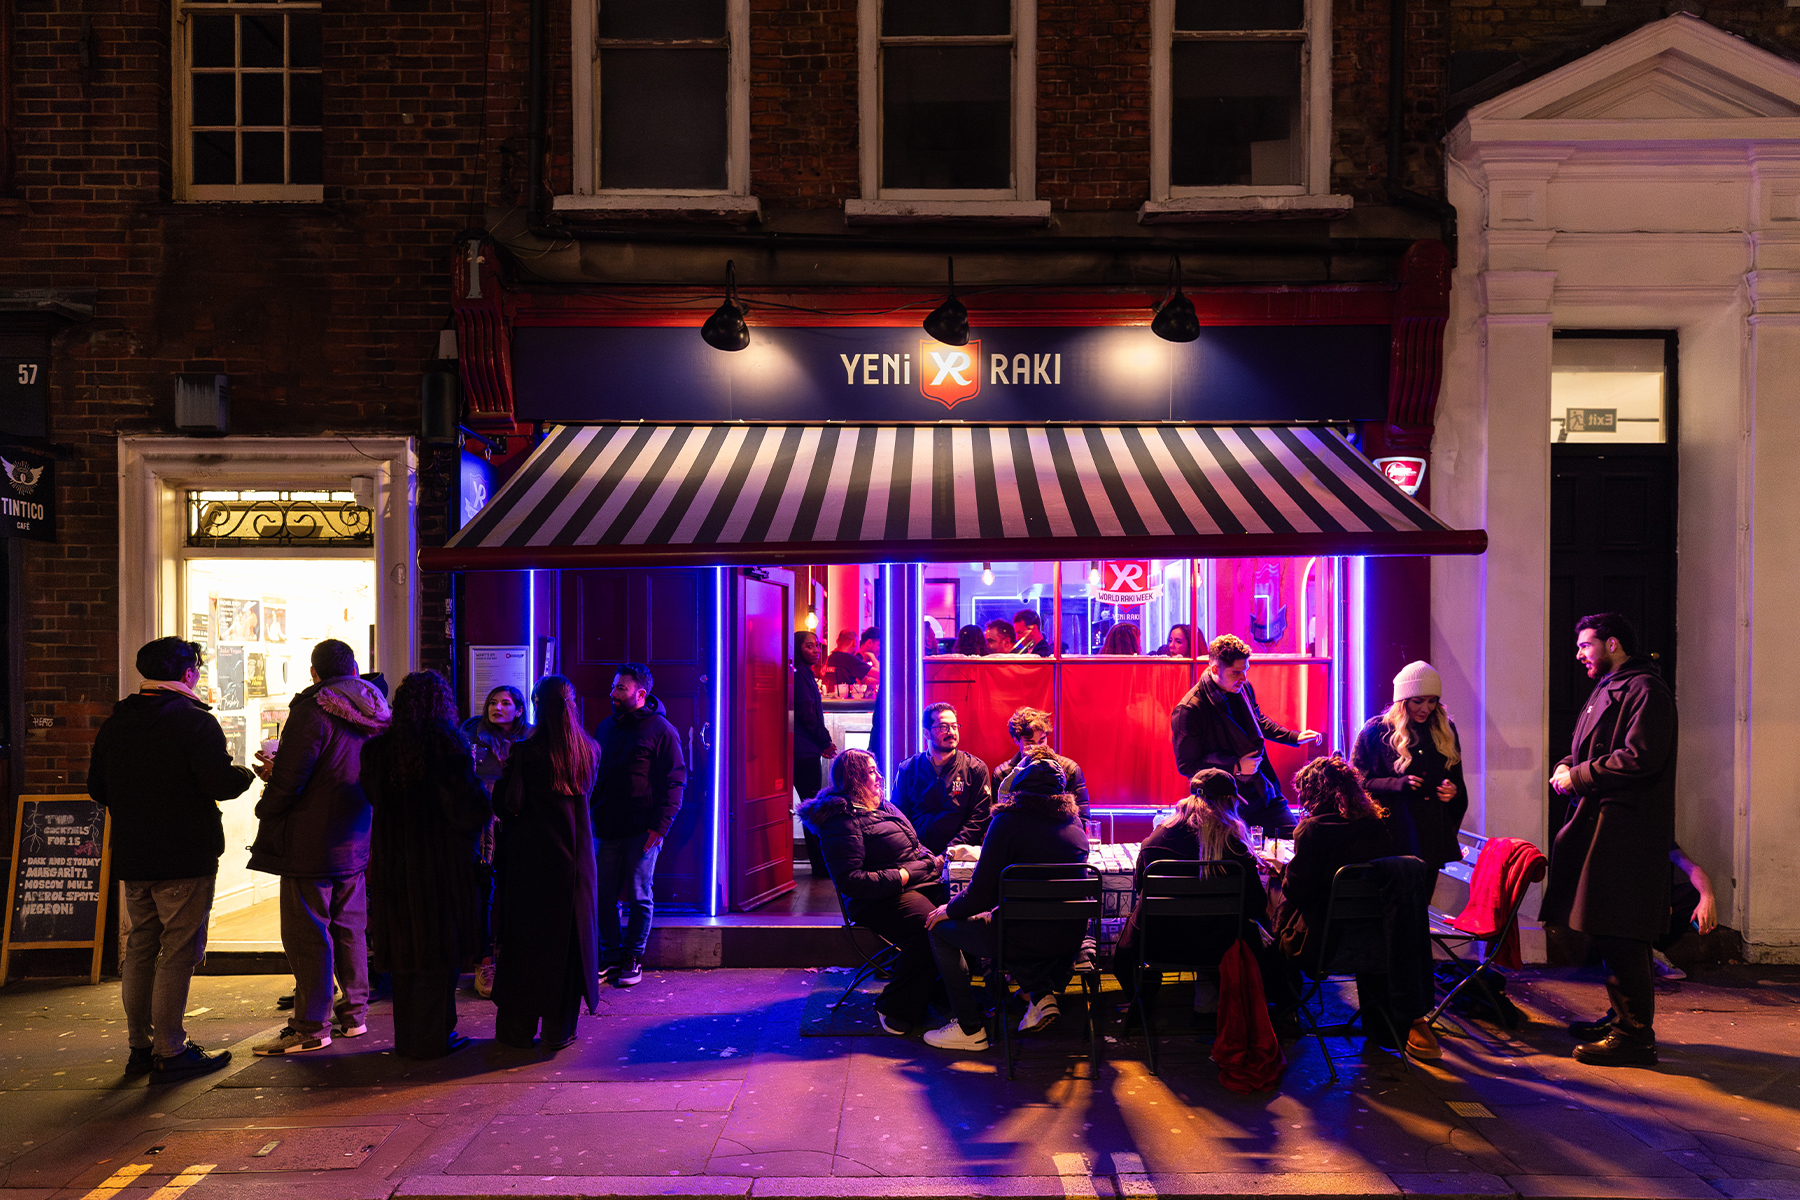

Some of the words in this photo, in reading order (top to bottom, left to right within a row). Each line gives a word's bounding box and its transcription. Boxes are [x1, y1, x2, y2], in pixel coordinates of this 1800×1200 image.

[990, 353, 1061, 385] RAKI
[18, 364, 38, 385] 57
[1, 497, 44, 521] TINTICO
[1099, 593, 1119, 602] WORLD
[1136, 592, 1154, 601] WEEK
[44, 814, 75, 825] TWO
[47, 837, 67, 845] FOR
[67, 837, 81, 845] 15
[48, 857, 66, 865] AND
[24, 880, 64, 889] MOSCOW
